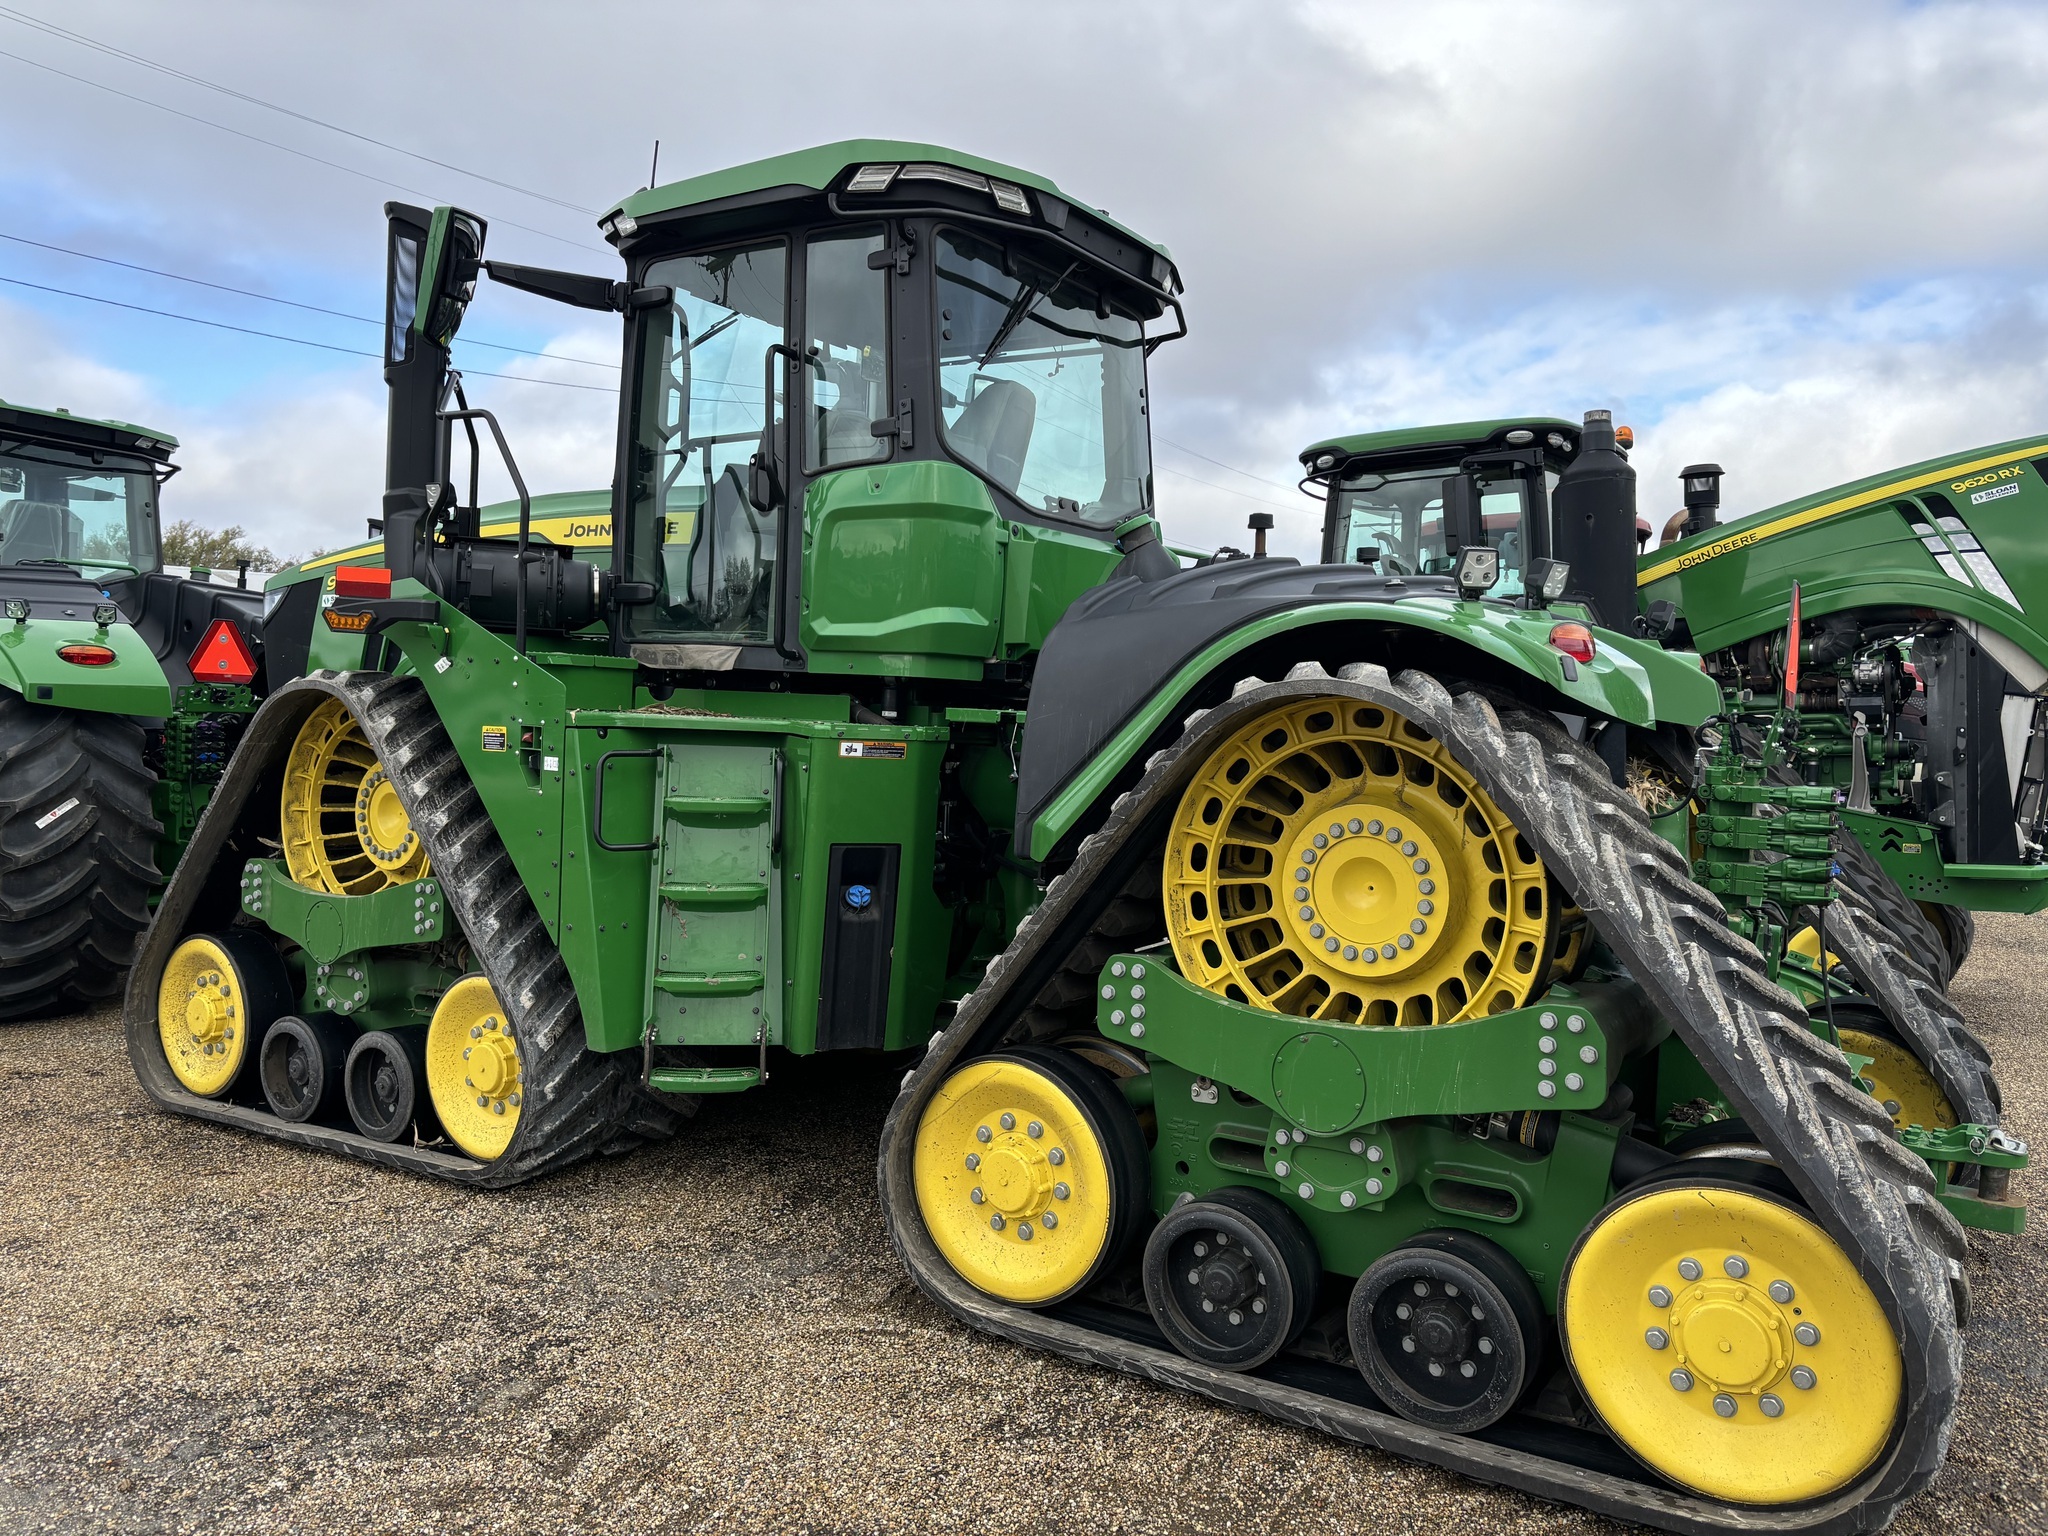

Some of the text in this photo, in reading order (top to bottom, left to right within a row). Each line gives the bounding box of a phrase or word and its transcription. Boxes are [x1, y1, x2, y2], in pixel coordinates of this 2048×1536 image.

[1950, 465, 2025, 494] 9620 RX
[1984, 484, 2017, 497] SLOAN
[563, 522, 612, 538] JOHN
[1675, 532, 1759, 571] JOHN DEERE
